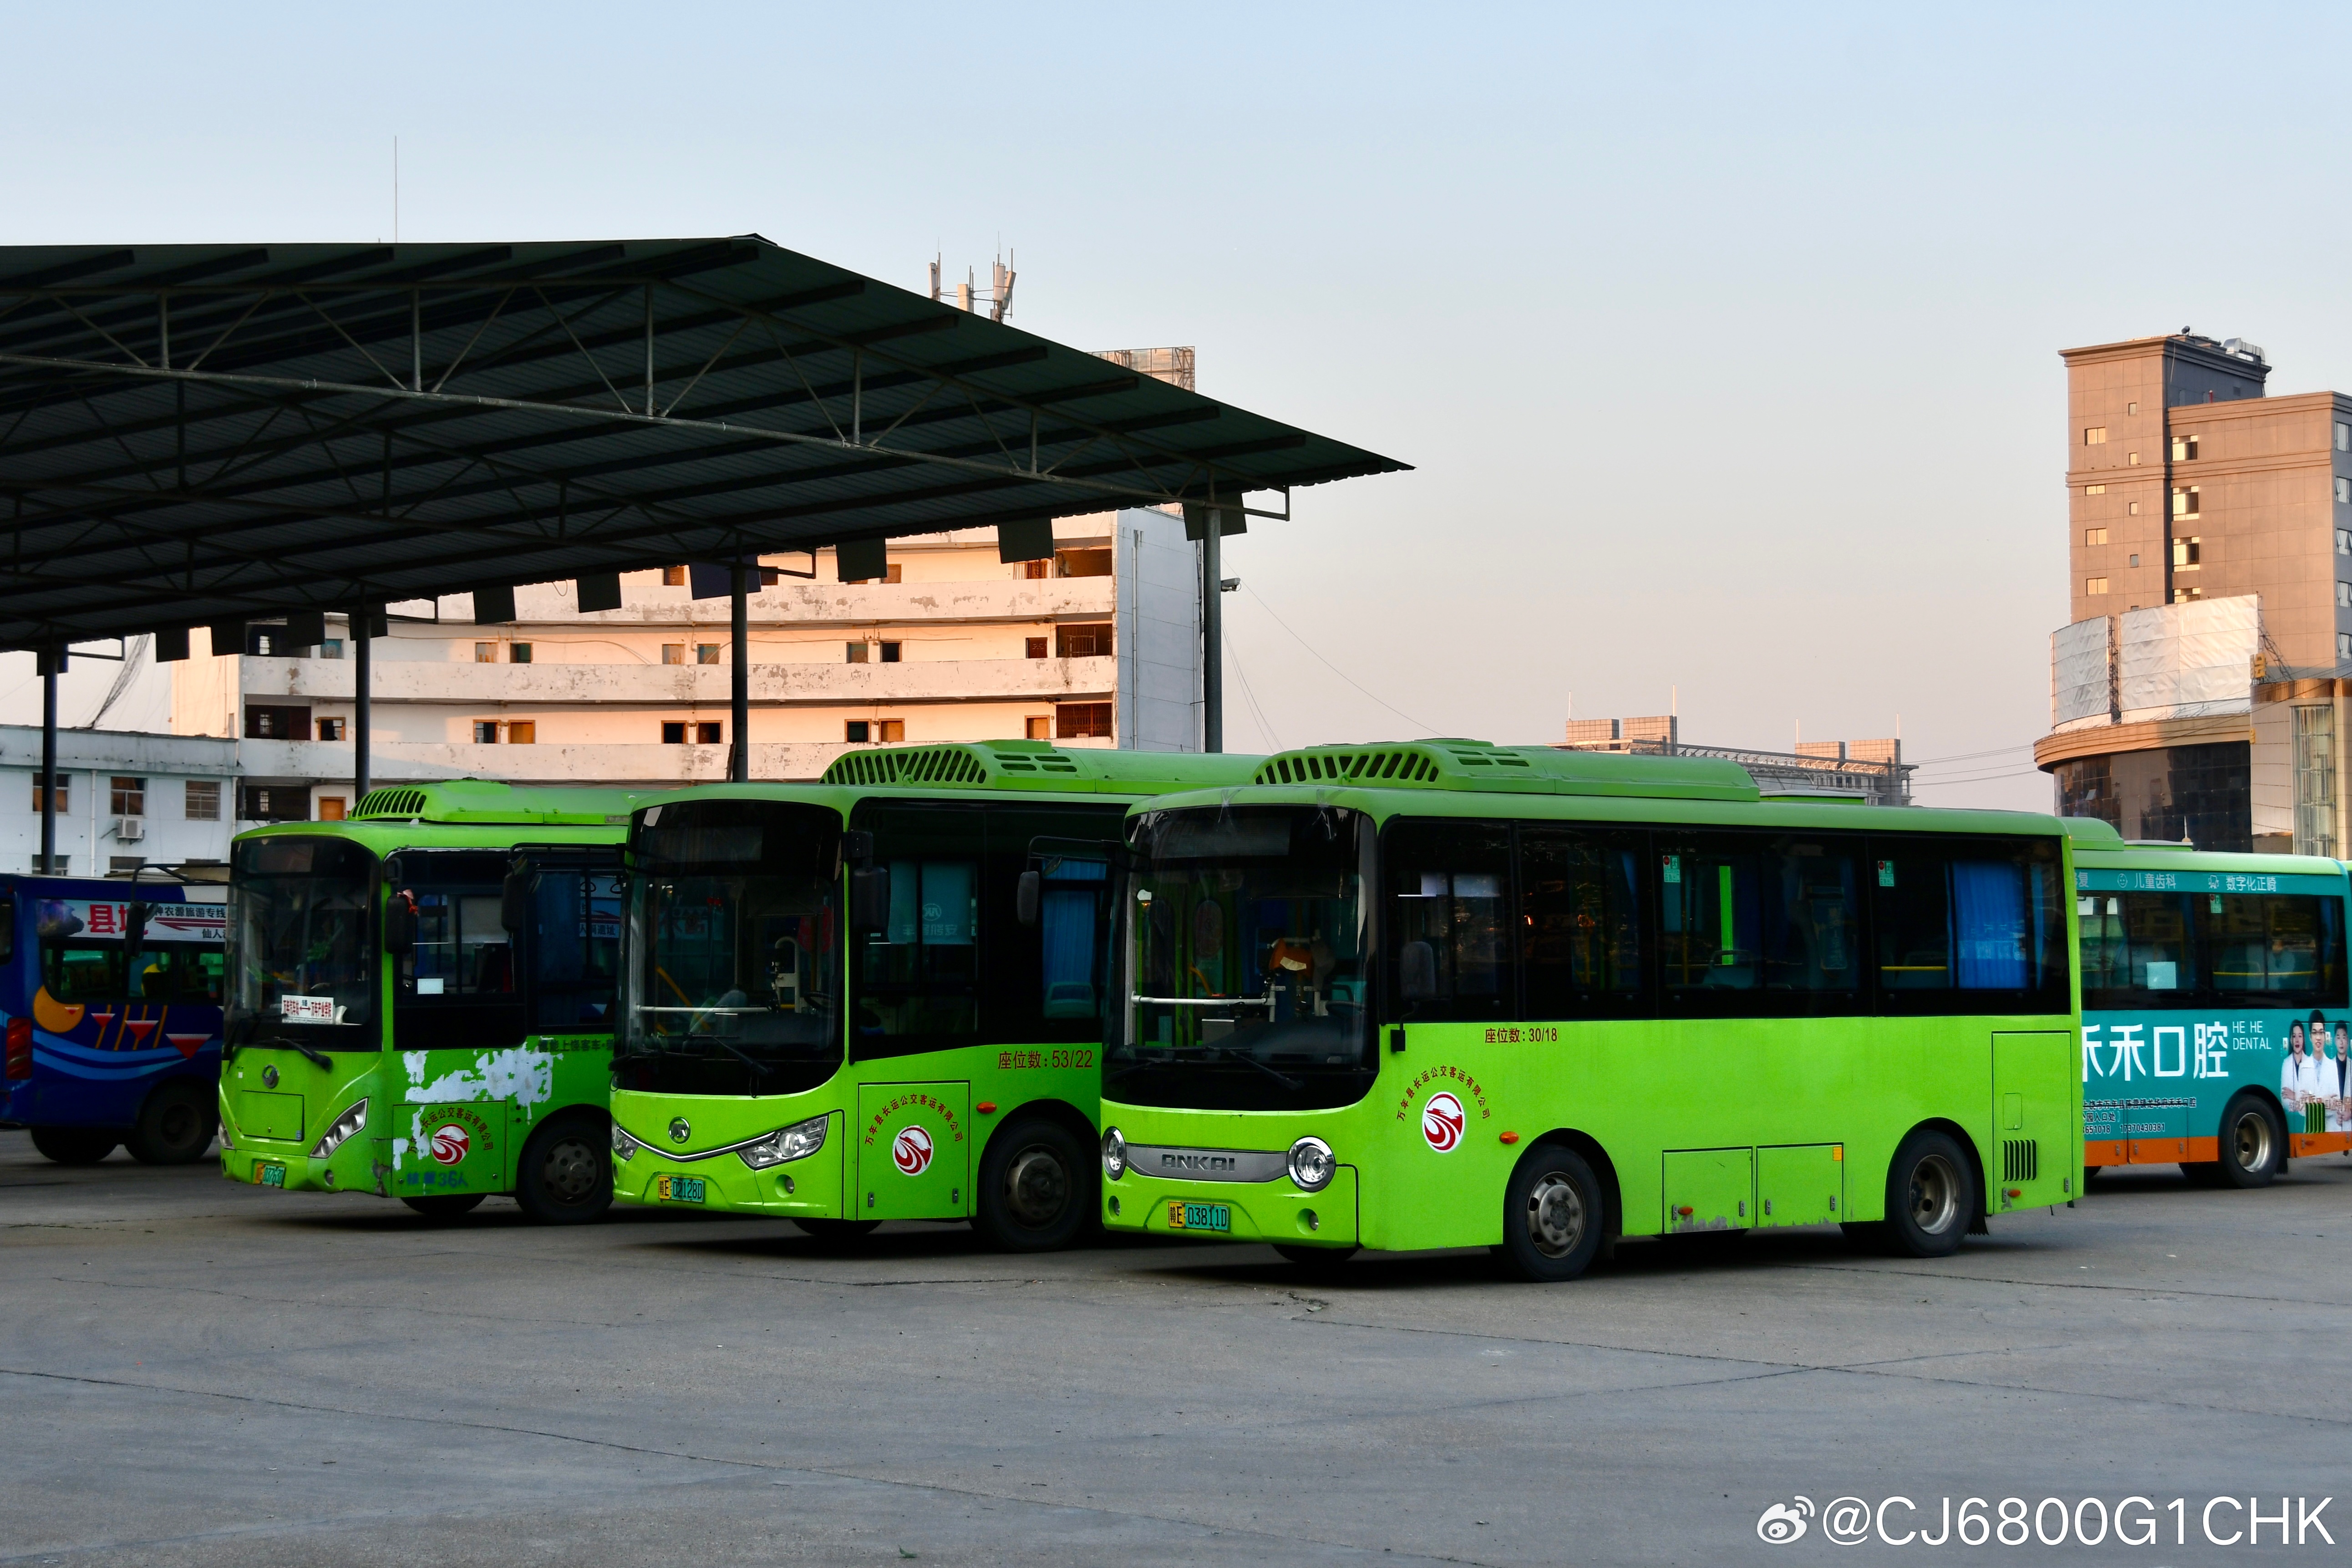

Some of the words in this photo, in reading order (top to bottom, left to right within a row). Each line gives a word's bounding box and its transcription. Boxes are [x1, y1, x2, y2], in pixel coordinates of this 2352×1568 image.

[2074, 872, 2089, 888] 复
[2134, 873, 2176, 888] 儿童齿科
[2226, 875, 2276, 892] 数字化正畸
[2232, 1021, 2245, 1033] HE
[2250, 1020, 2263, 1033] HE
[2233, 1037, 2271, 1050] DENTAL
[1397, 1065, 1490, 1121] 万年县长运公交客运有限公司
[865, 1093, 963, 1146] 万年县长运公交客运有限公司
[407, 1106, 493, 1153] 万长运公交客运有限公司
[2120, 1123, 2165, 1133] 17370430381
[1162, 1154, 1235, 1172] ANKAI
